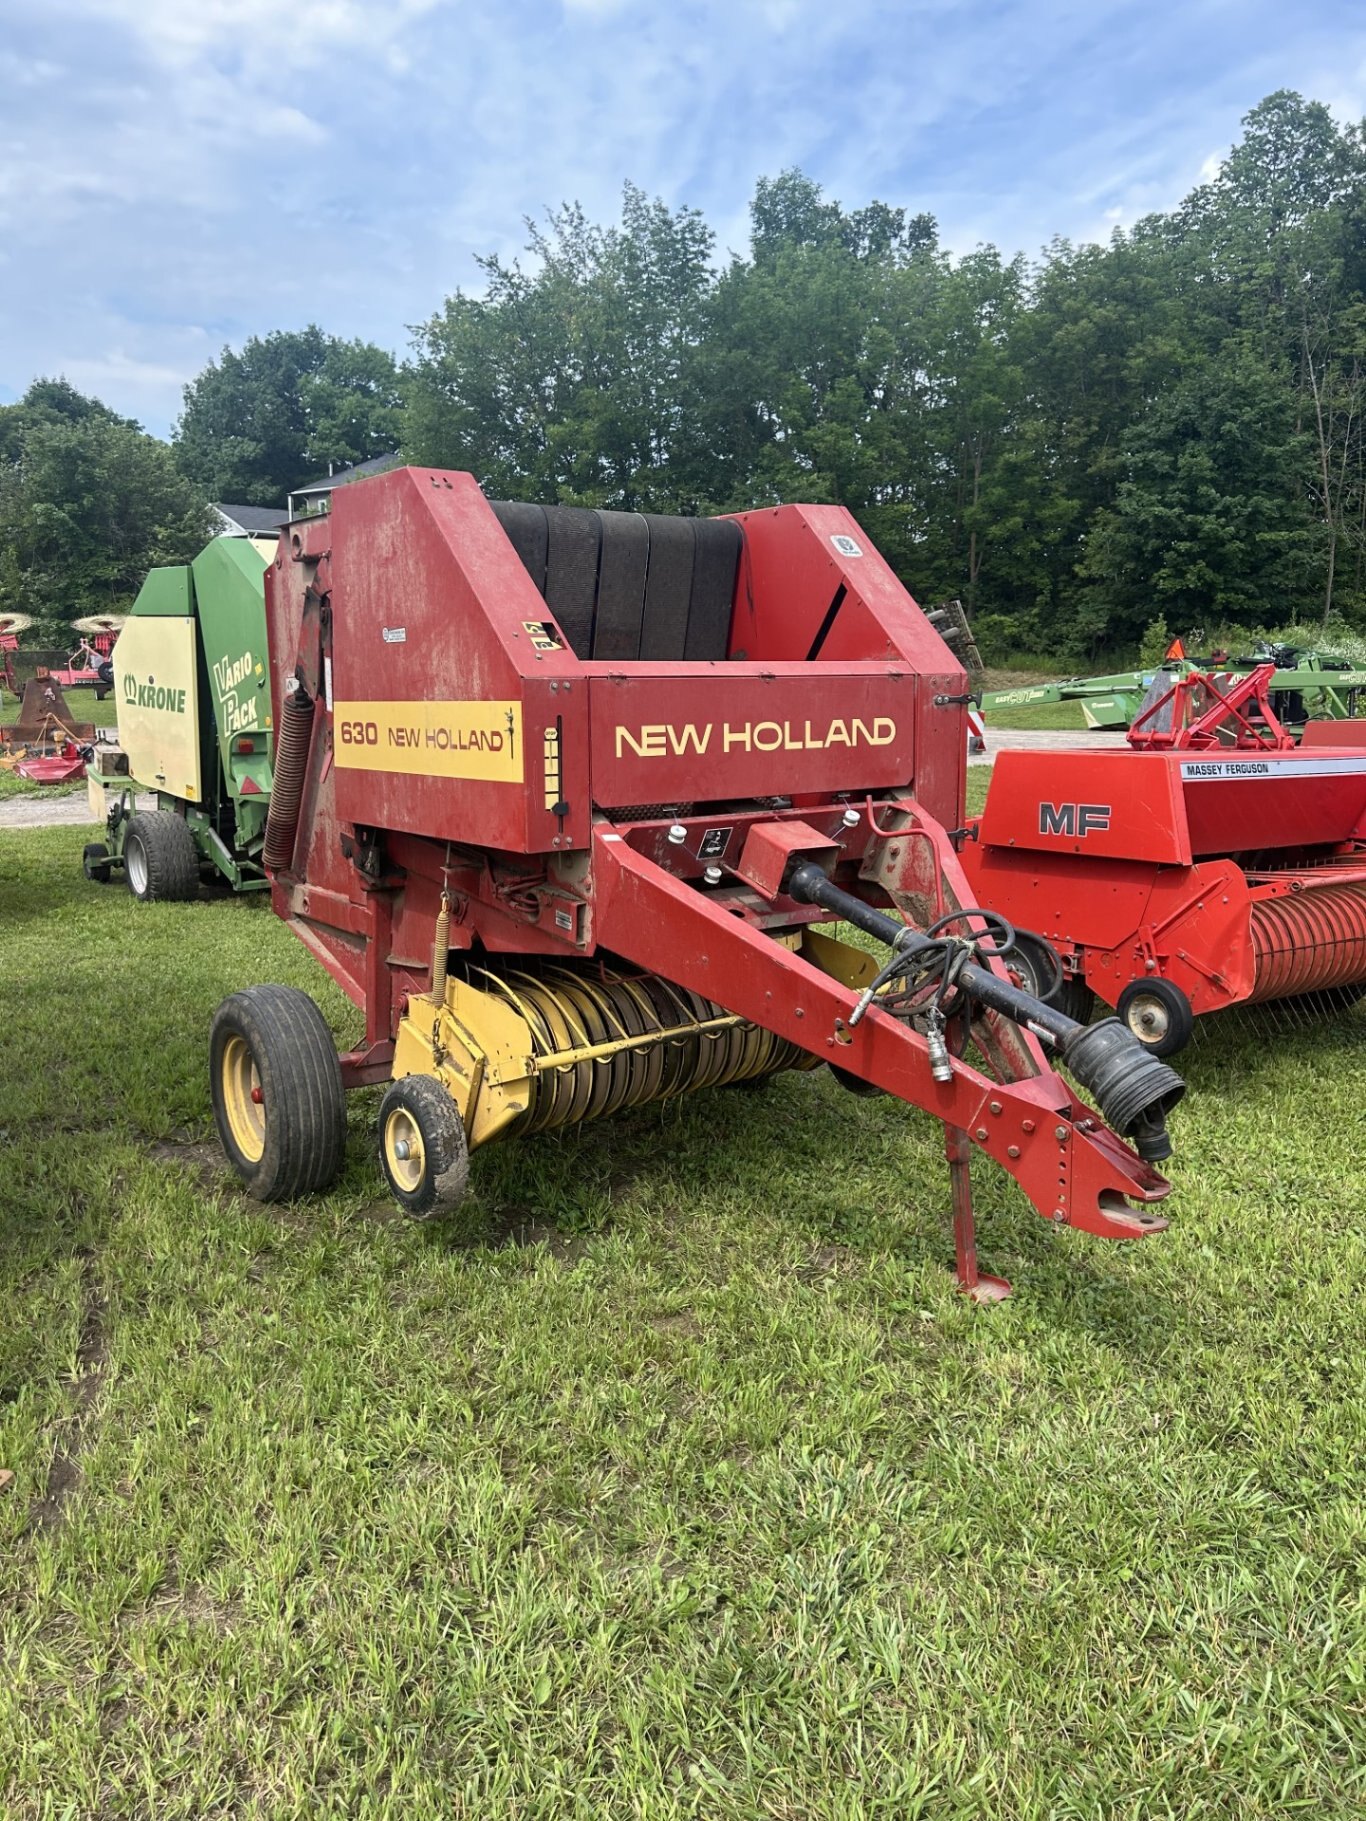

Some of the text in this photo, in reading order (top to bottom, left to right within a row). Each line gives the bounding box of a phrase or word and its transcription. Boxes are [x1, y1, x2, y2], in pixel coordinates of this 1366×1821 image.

[213, 651, 252, 703] VARIO
[138, 684, 186, 713] KRONE
[222, 690, 258, 738] PACK
[341, 722, 504, 752] 630 NEW HOLLAND
[615, 717, 896, 758] NEW HOLLAND
[1187, 763, 1269, 775] MASSEY FERGUSON
[1039, 802, 1112, 837] MF
